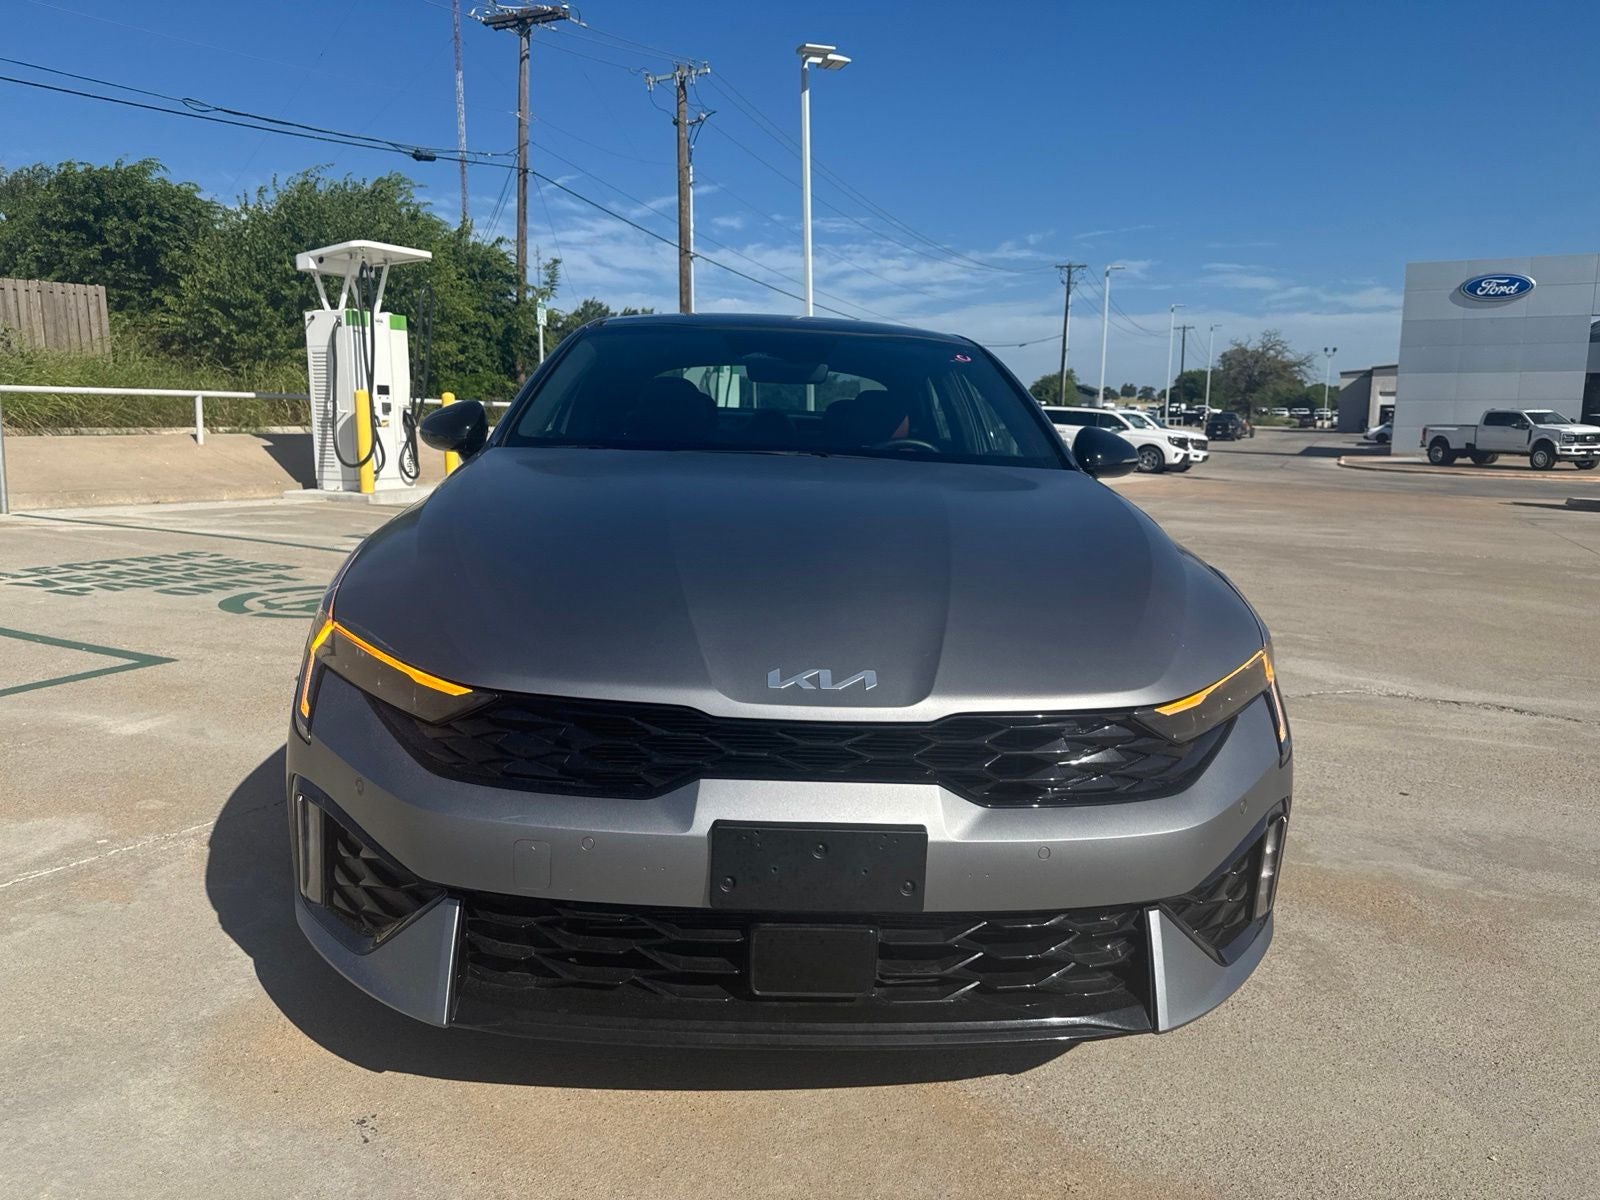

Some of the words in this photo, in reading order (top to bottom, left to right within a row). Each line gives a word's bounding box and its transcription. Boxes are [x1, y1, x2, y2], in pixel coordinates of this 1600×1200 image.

[1476, 279, 1520, 295] Ford
[0, 551, 224, 581] LECTRIC
[5, 558, 258, 588] VEHICLE
[44, 563, 302, 596] PARKING
[153, 573, 304, 596] ONLY
[767, 668, 877, 690] KIA
